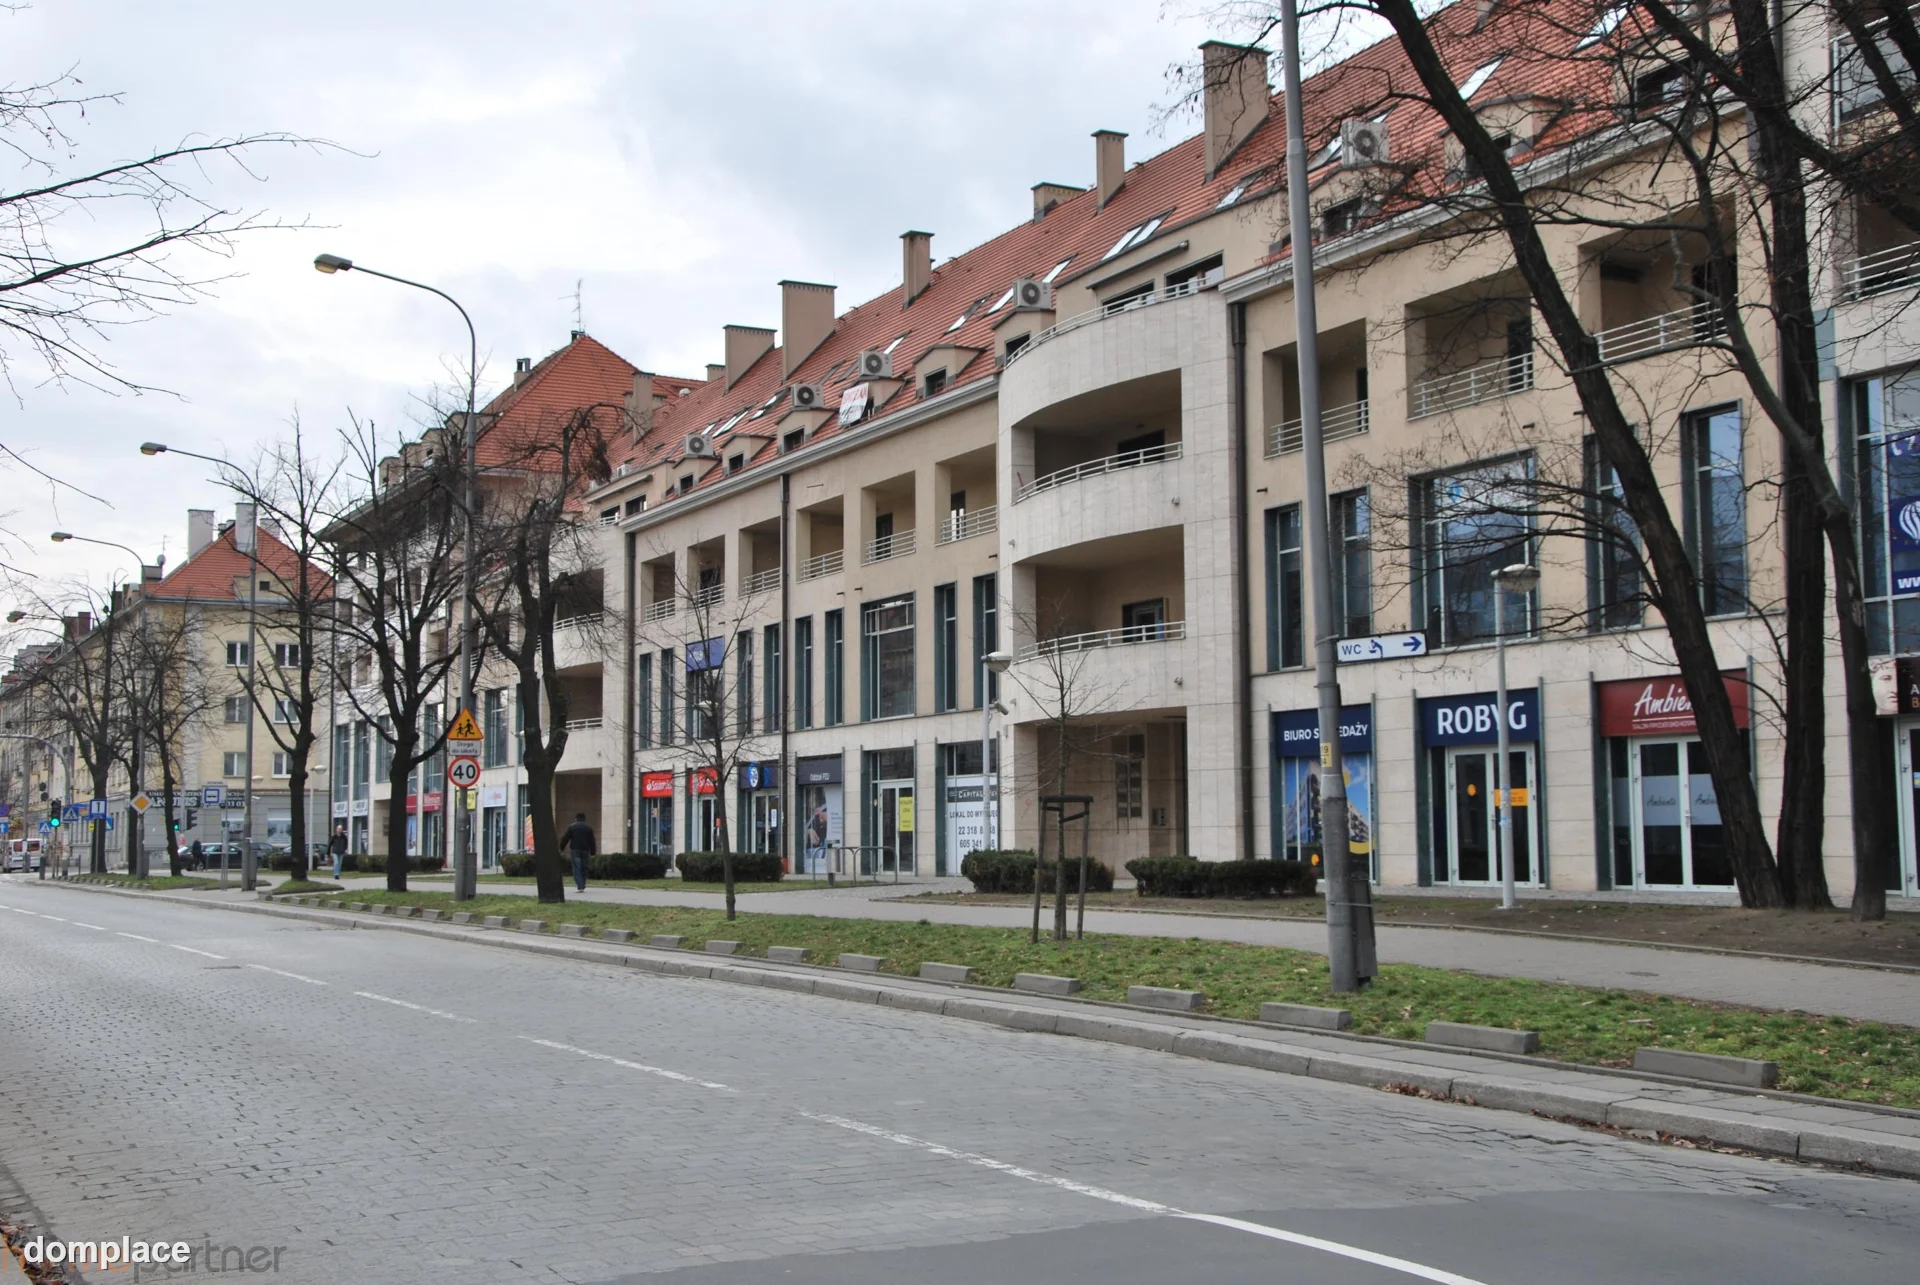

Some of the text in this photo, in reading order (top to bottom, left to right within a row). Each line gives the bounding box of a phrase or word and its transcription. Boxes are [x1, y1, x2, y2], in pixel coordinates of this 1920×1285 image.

[1341, 644, 1362, 655] WC
[1283, 729, 1312, 742] BIURO
[453, 764, 476, 780] 40
[958, 826, 966, 835] 22
